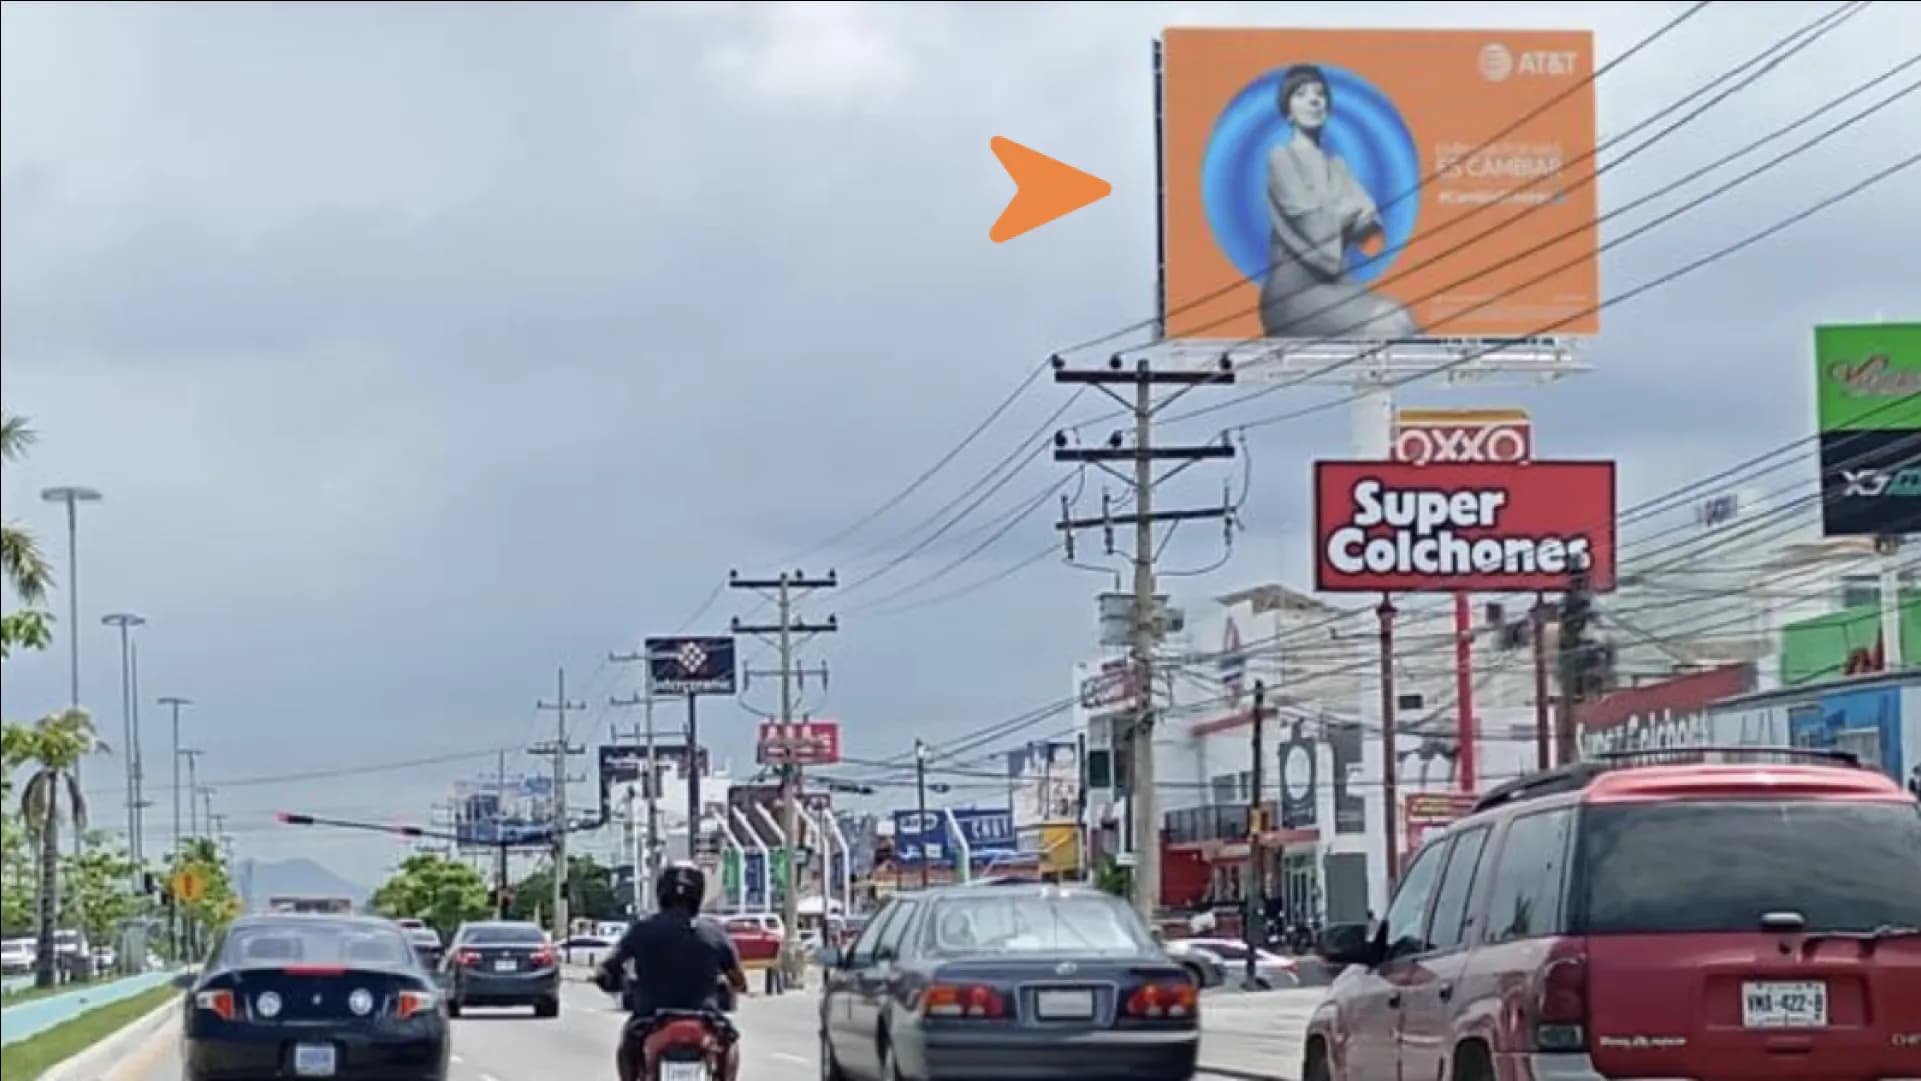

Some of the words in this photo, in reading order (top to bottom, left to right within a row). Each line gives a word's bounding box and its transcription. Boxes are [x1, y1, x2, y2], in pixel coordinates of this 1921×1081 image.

[1518, 51, 1577, 75] AT&T
[1398, 428, 1528, 465] OXXO
[1353, 481, 1507, 535] Super
[1327, 528, 1590, 573] Colchones
